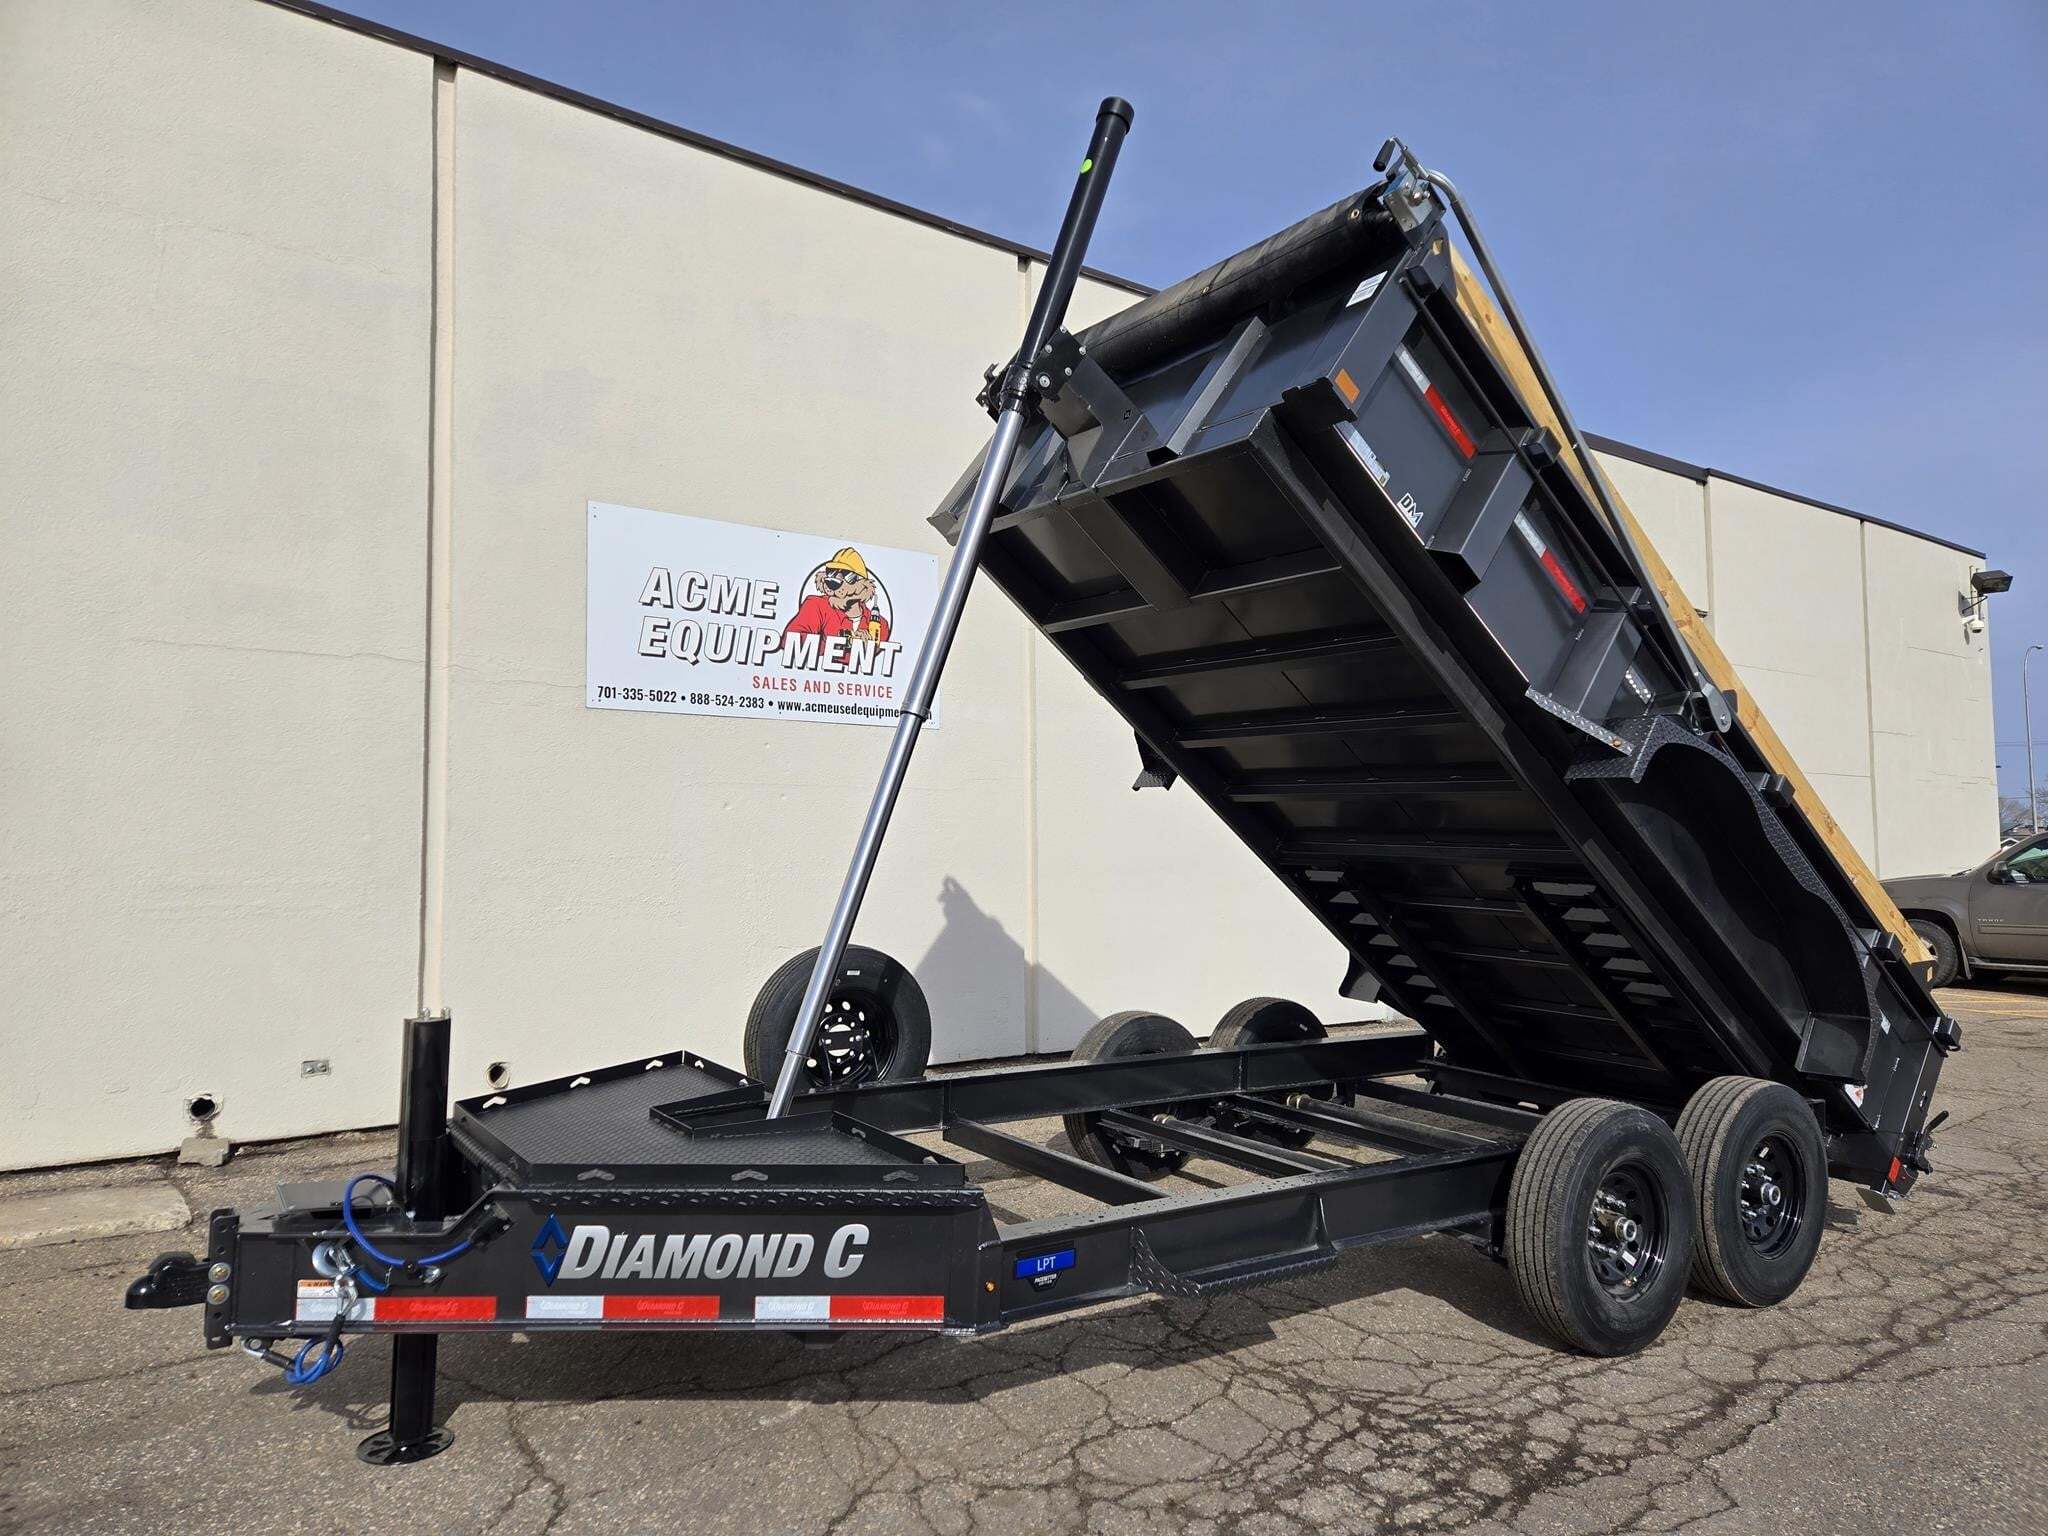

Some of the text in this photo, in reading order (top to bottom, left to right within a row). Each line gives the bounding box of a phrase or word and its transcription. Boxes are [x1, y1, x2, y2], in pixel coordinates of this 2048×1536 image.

[638, 566, 779, 619] ACME
[637, 615, 902, 677] EQUIPMENT
[597, 685, 932, 720] 701-335-5022 888-524-2383 www.acmeusedequipme
[752, 675, 893, 699] SALES AND SERVICE
[557, 1223, 870, 1280] DIAMOND C
[1037, 1255, 1056, 1272] LPT
